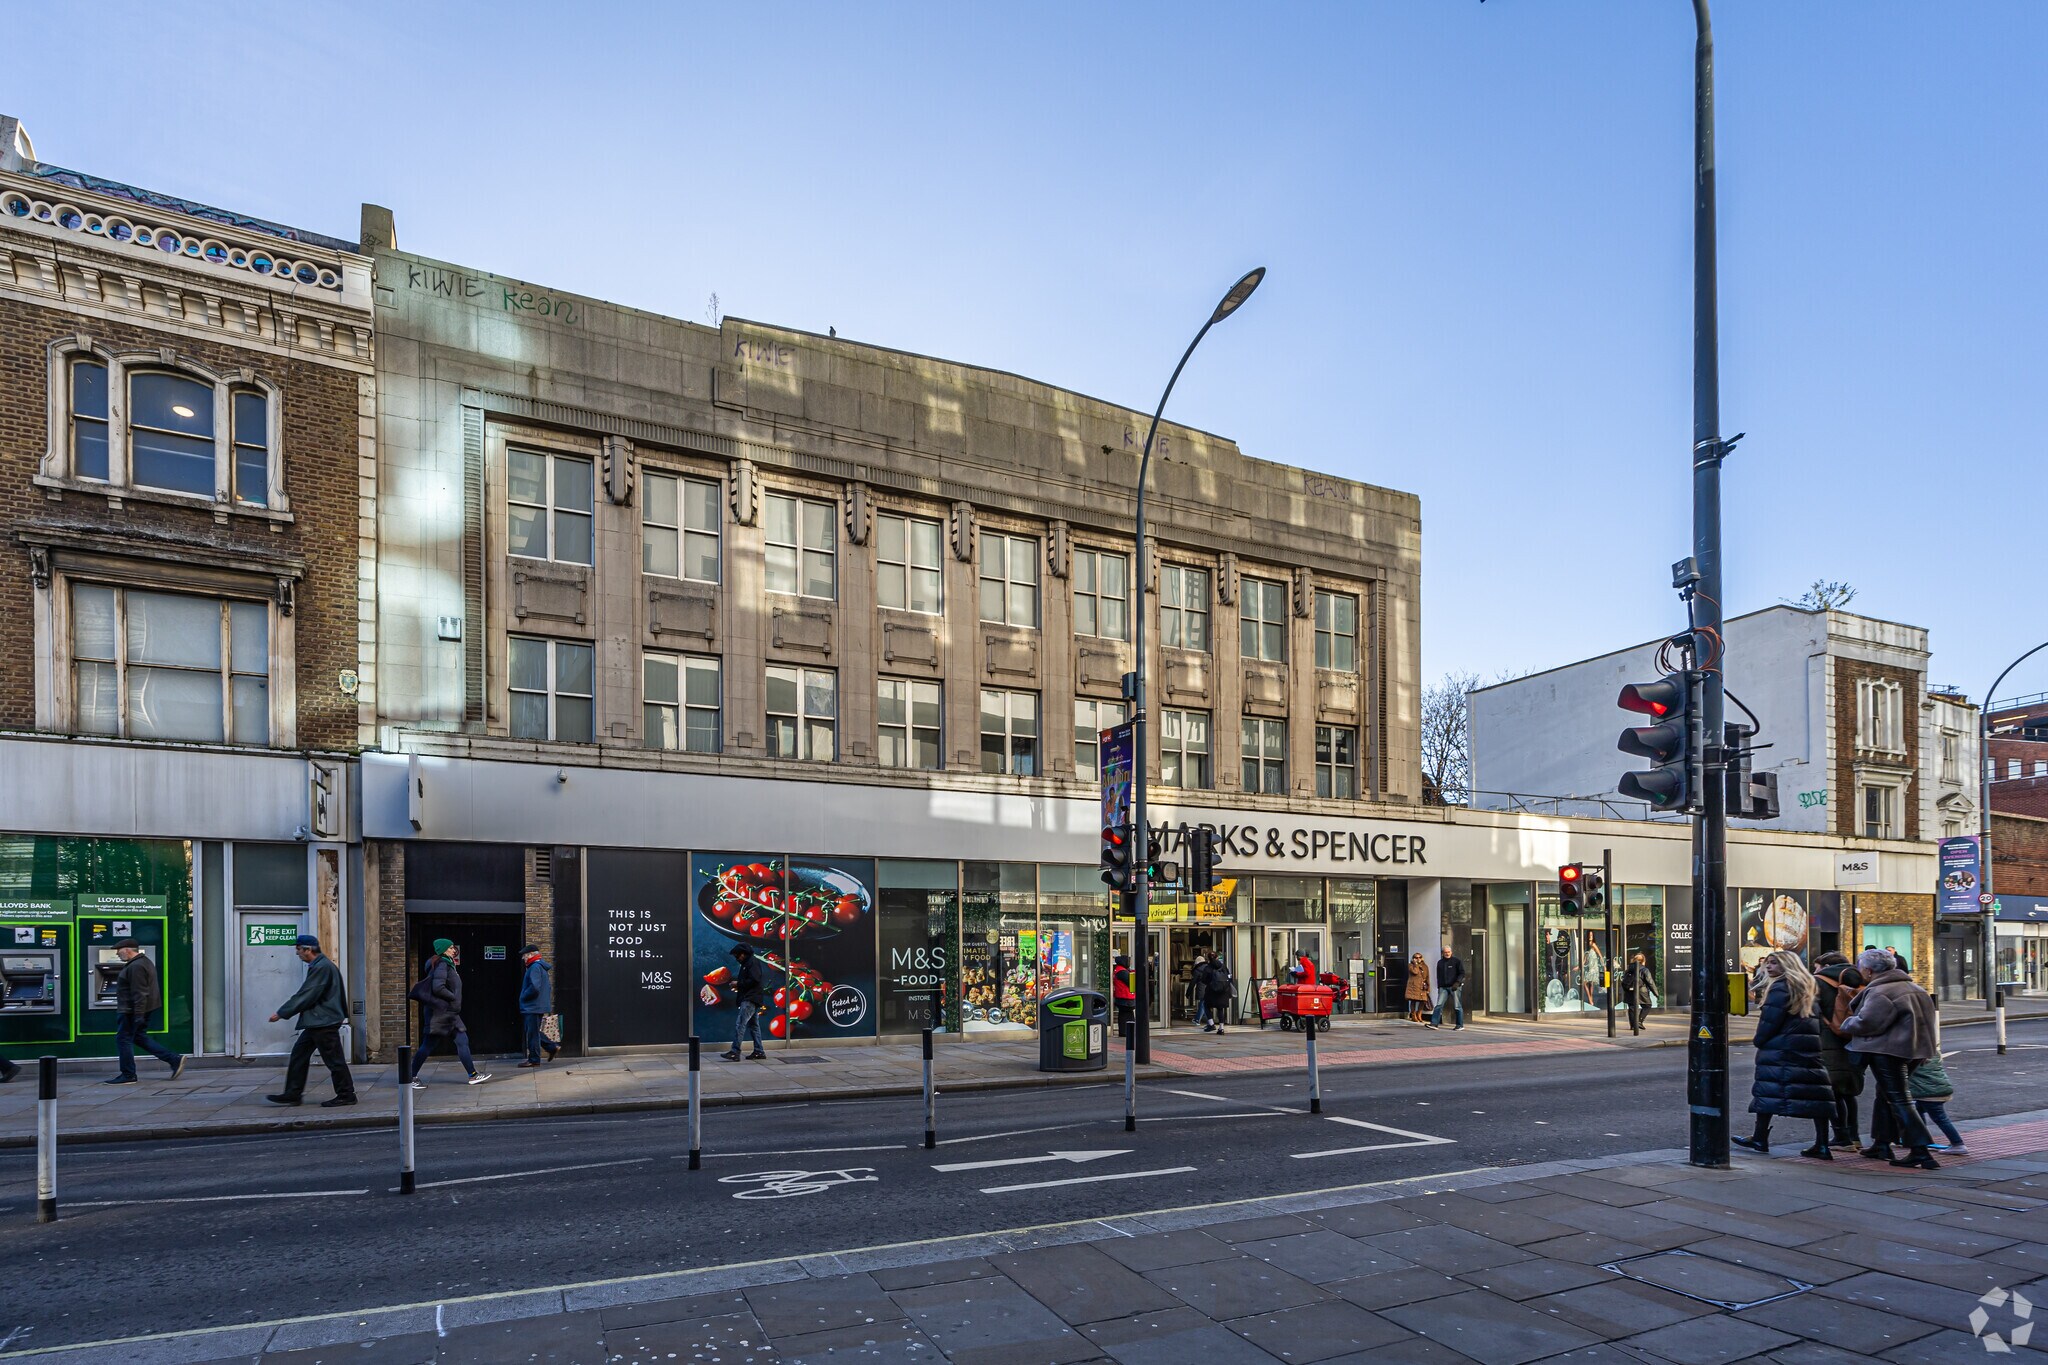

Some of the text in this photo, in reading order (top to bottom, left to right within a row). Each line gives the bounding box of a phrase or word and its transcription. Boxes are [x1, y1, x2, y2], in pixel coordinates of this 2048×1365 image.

[1265, 827, 1286, 857] &
[1291, 828, 1427, 864] SPENCER
[1842, 862, 1869, 872] M&S
[608, 909, 652, 919] THIS IS
[608, 923, 667, 932] NOT JUST
[1671, 923, 1688, 931] CLICK
[1670, 931, 1693, 939] COLLEC
[609, 936, 643, 945] FOOD
[608, 949, 663, 958] THIS IS...
[892, 947, 946, 970] M&S
[641, 971, 672, 984] M&S
[901, 975, 938, 985] FOOD
